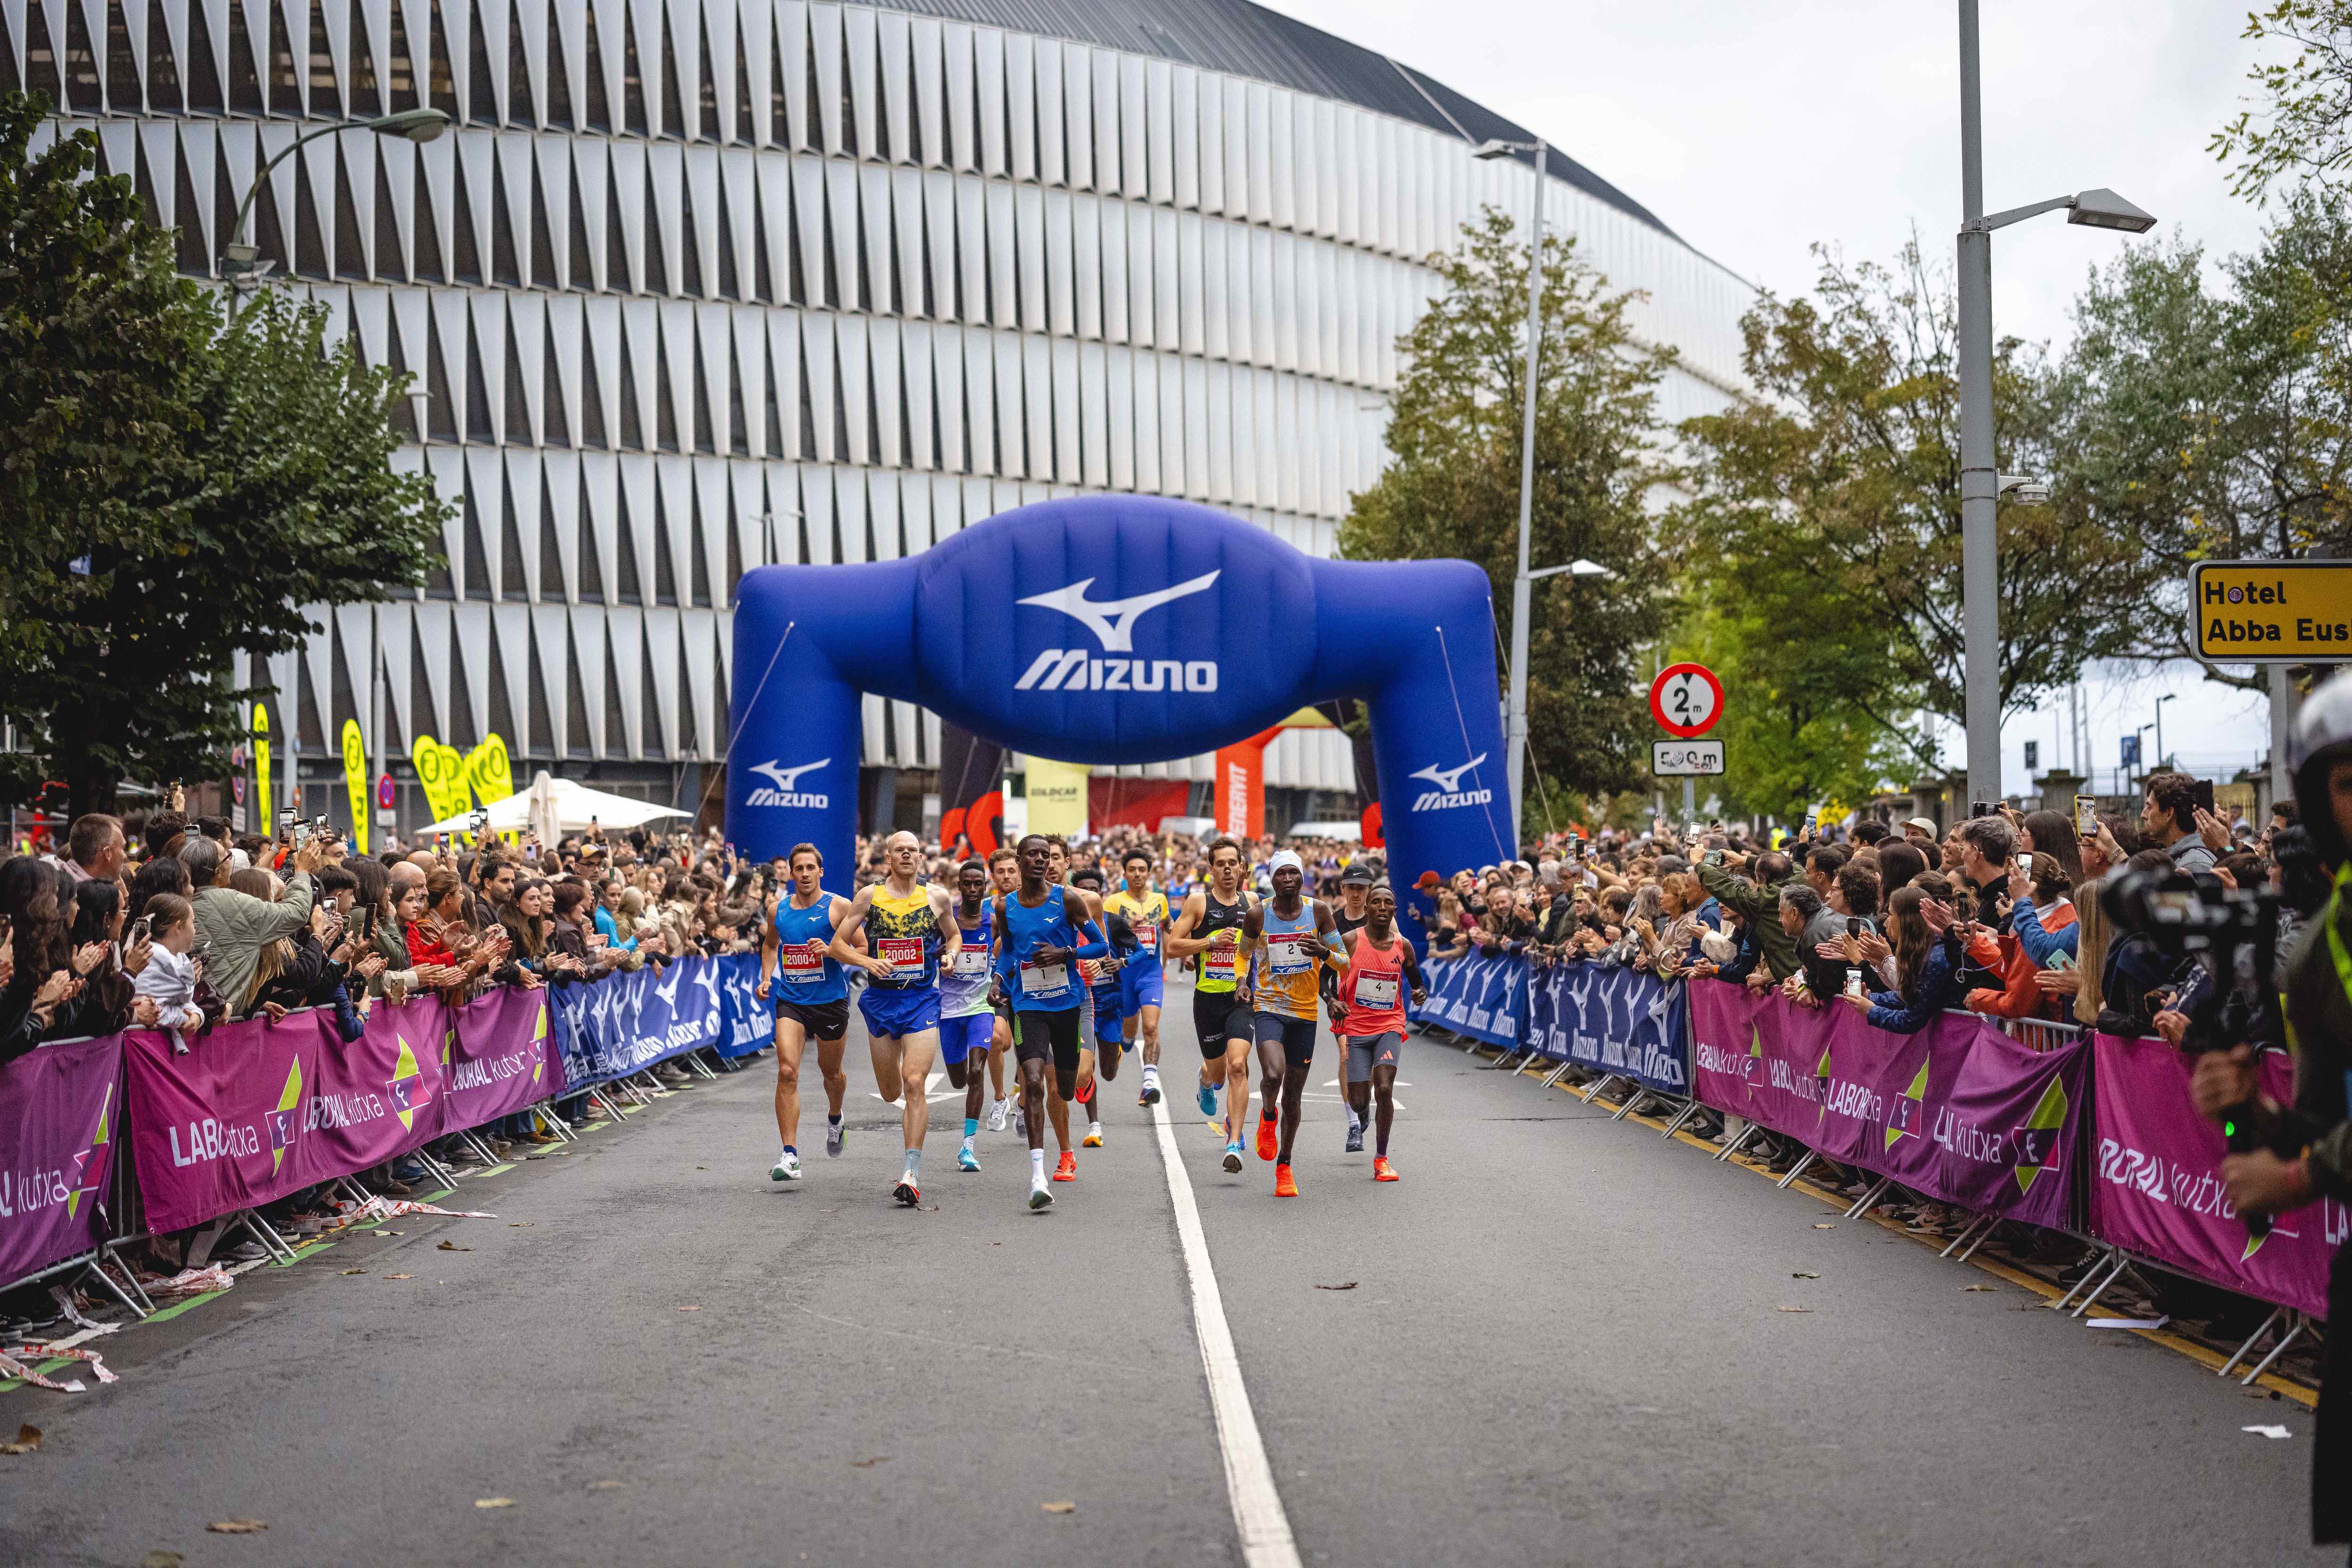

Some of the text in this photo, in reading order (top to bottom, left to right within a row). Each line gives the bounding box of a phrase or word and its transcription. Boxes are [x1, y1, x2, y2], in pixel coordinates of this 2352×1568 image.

[2205, 581, 2287, 604] Hotel
[2207, 619, 2352, 641] Abba Eus
[1014, 650, 1217, 692] MIZUNO
[1674, 687, 1689, 712] 2
[1704, 754, 1716, 764] m
[746, 788, 828, 808] MIZUNO
[1412, 789, 1492, 811] MIZUNO
[886, 949, 916, 960] 20002
[1288, 944, 1294, 954] 2
[787, 954, 815, 965] 20004
[966, 954, 971, 963] 5
[1212, 952, 1236, 963] 2000
[1041, 969, 1045, 979] 1
[1375, 982, 1381, 991] 4
[1956, 1119, 2002, 1164] kutxa
[18, 1167, 70, 1214] kutxa
